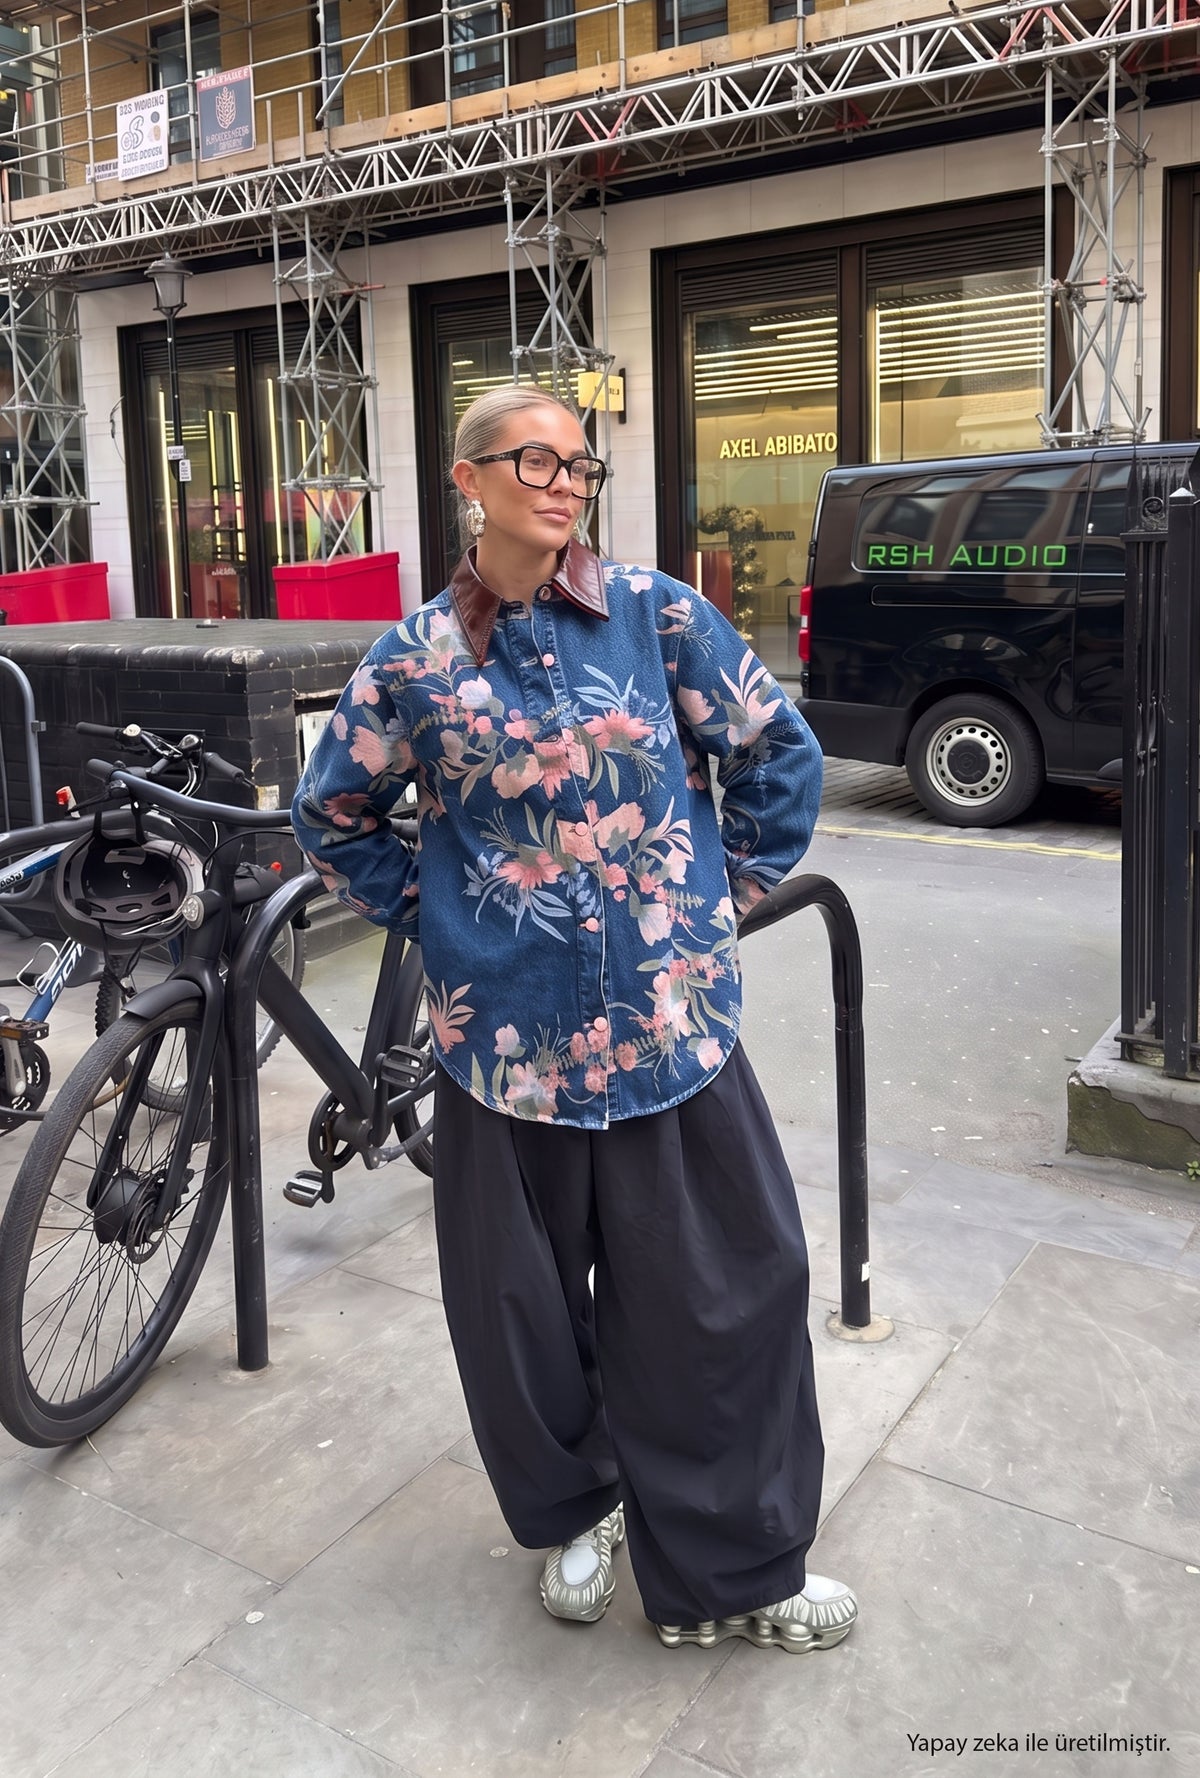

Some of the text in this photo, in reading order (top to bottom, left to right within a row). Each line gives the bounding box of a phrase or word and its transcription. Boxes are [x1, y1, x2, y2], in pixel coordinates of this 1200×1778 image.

[720, 432, 838, 459] AXEL ABIBATO
[868, 544, 1067, 566] RSH AUDIO
